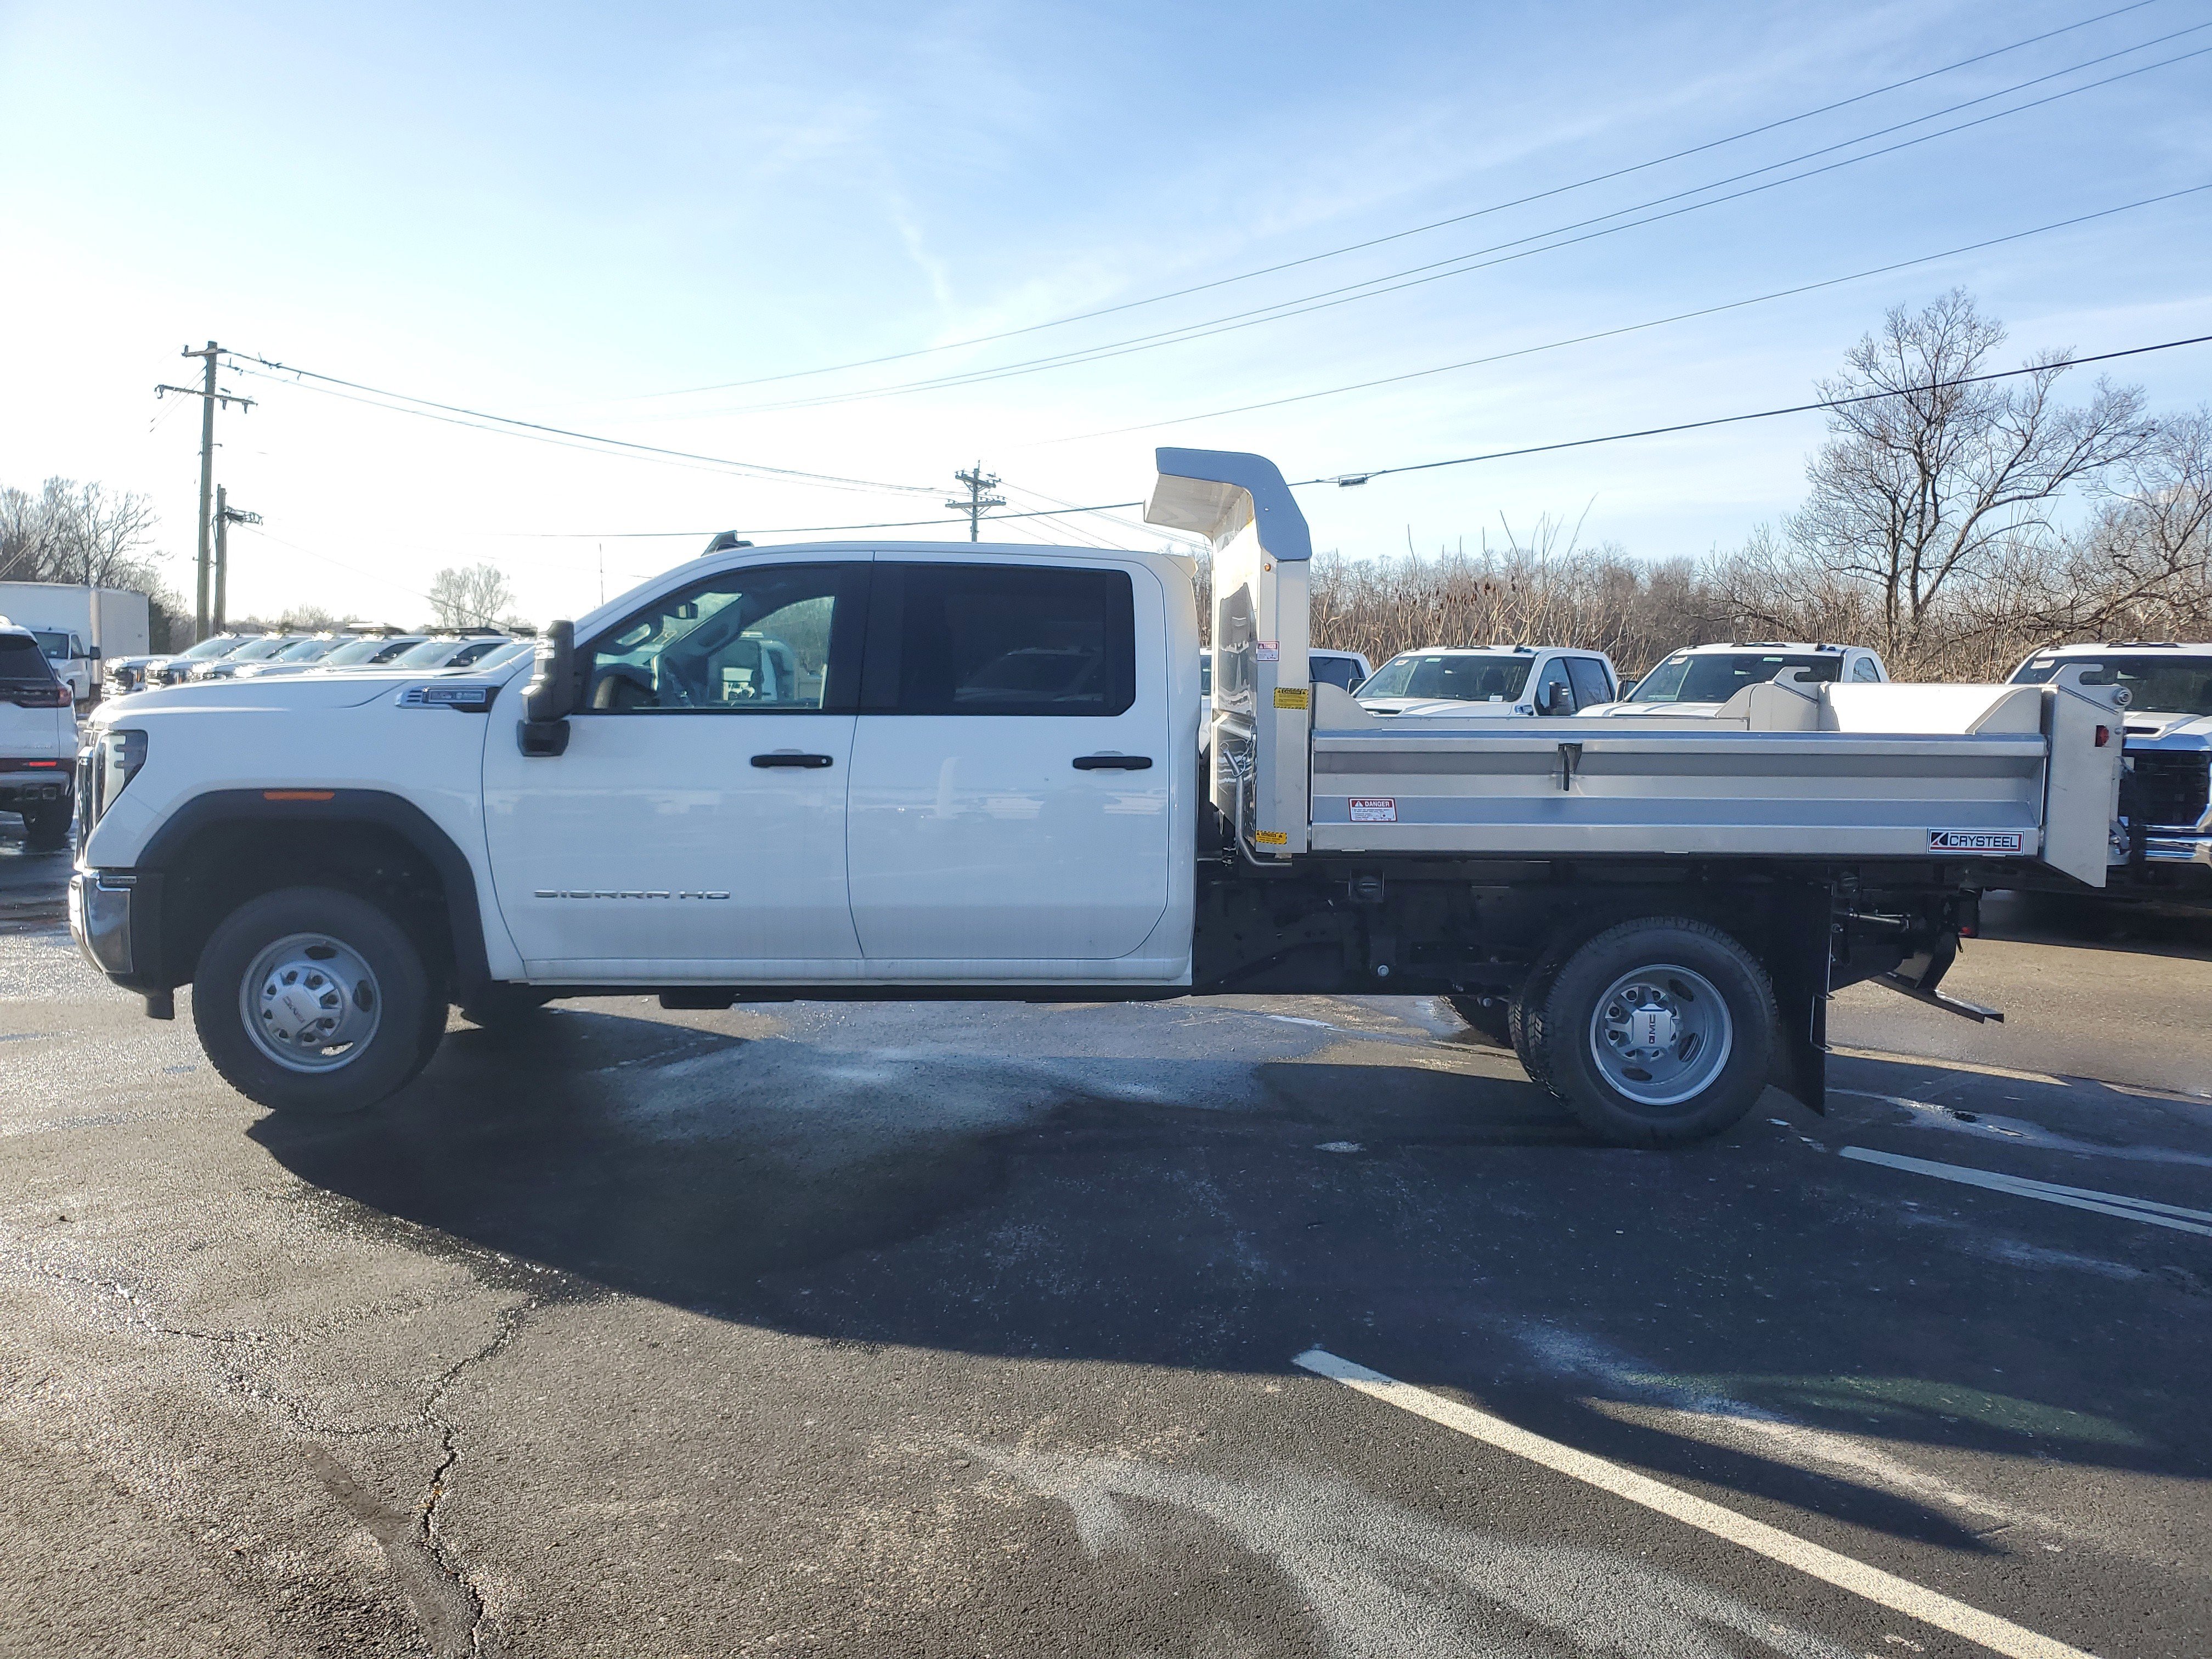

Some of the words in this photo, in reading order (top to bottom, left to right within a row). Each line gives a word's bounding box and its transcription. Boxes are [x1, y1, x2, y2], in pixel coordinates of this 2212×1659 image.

[1950, 836, 2017, 847] CRYSTEEL
[534, 889, 670, 899] SIERRA
[679, 890, 731, 899] HD
[1648, 1014, 1656, 1044] GMC
